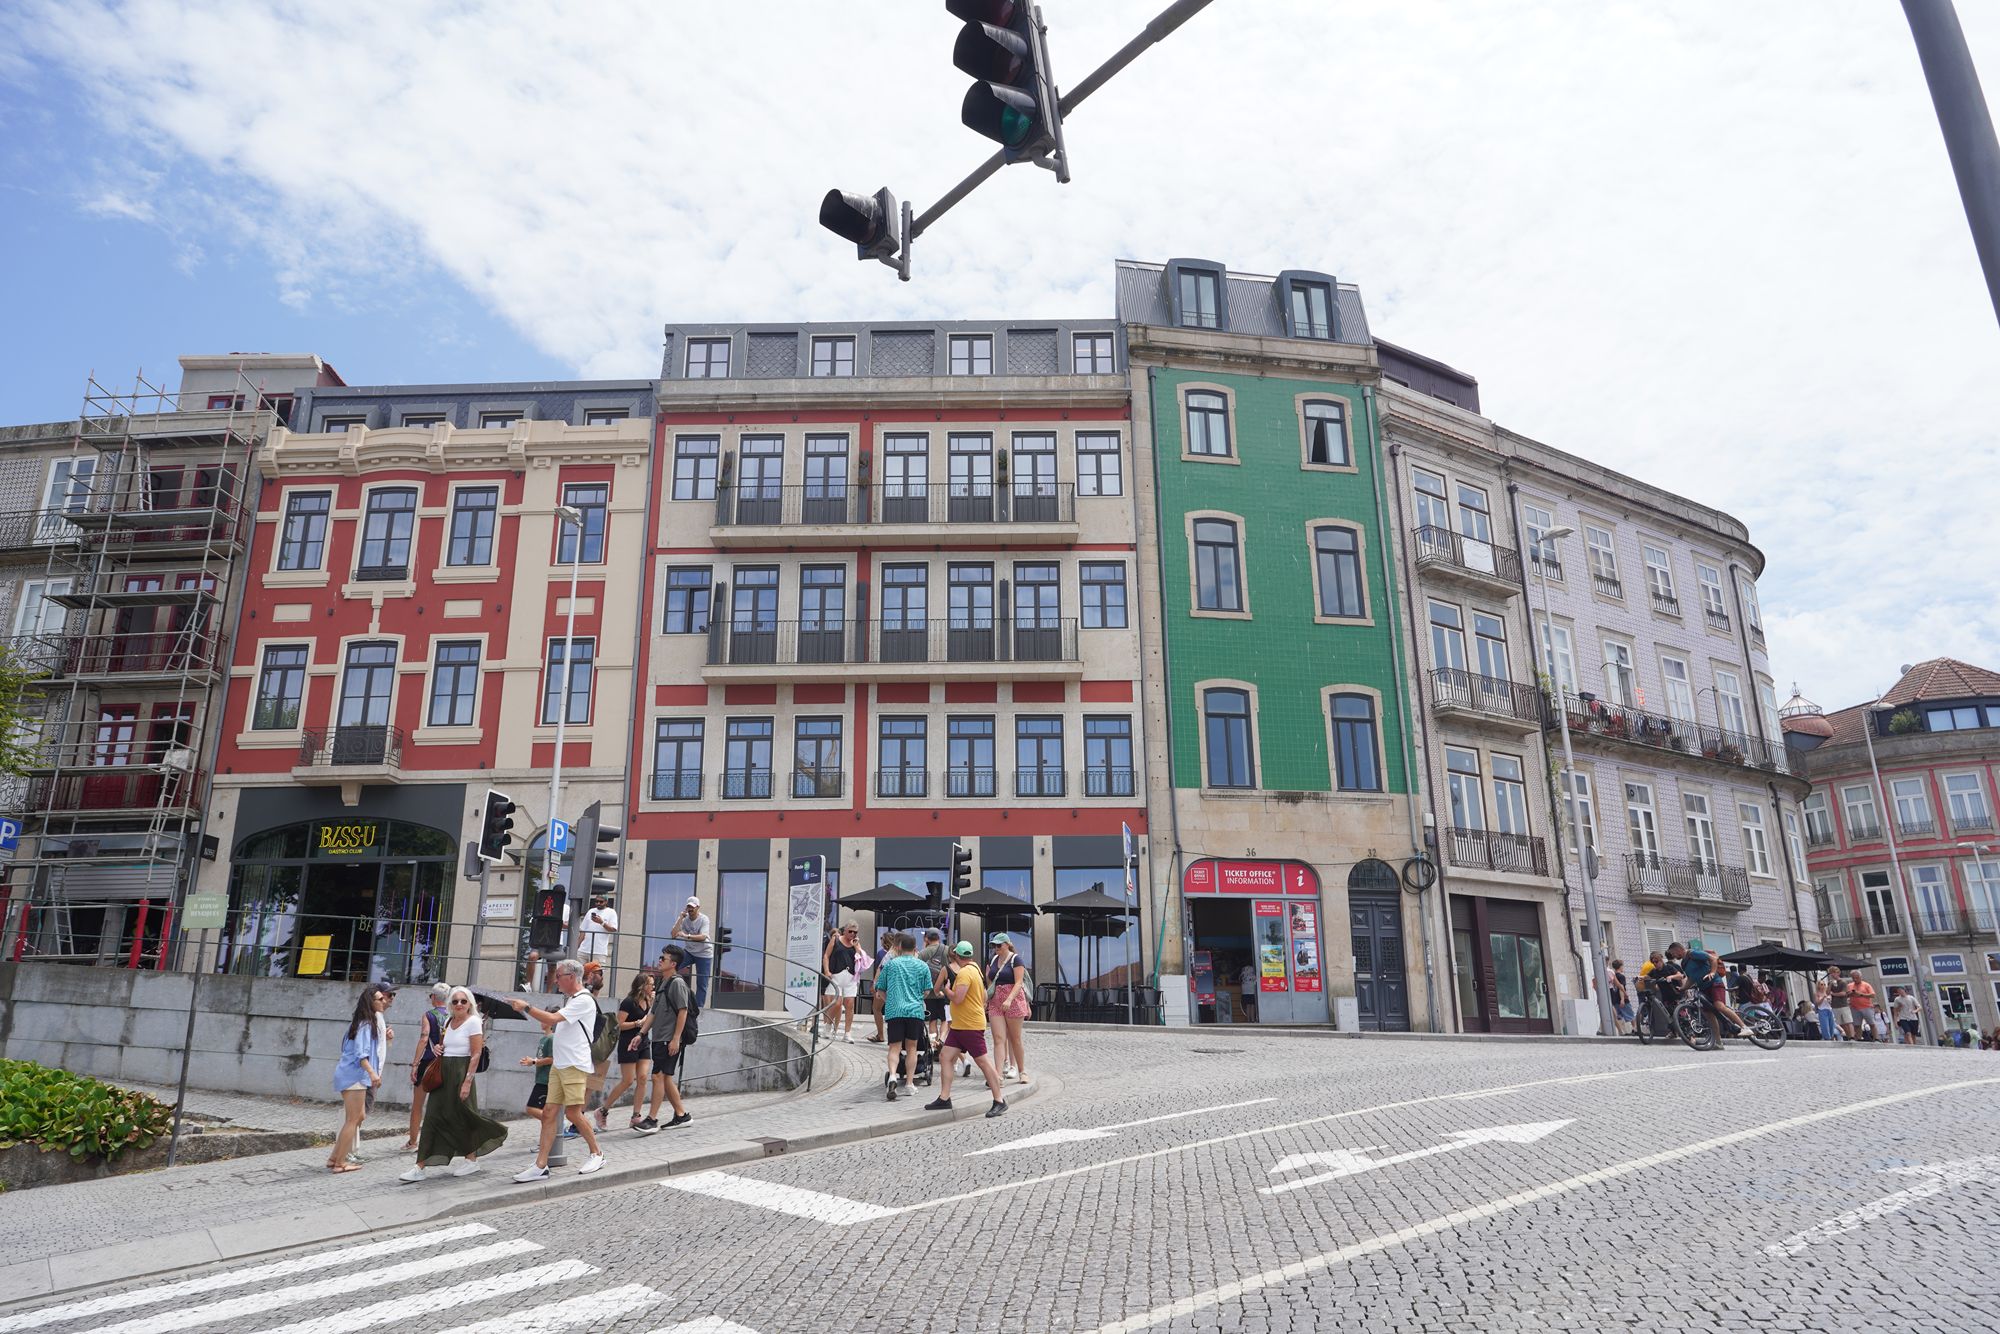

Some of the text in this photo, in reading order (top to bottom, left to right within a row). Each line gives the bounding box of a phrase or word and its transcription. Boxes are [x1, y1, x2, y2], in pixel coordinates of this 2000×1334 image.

[0, 821, 16, 845] P
[553, 822, 564, 848] P
[1245, 847, 1257, 857] 36
[1367, 848, 1377, 858] 32
[1224, 869, 1247, 877] TICKET
[1227, 877, 1275, 885] INFORMATION
